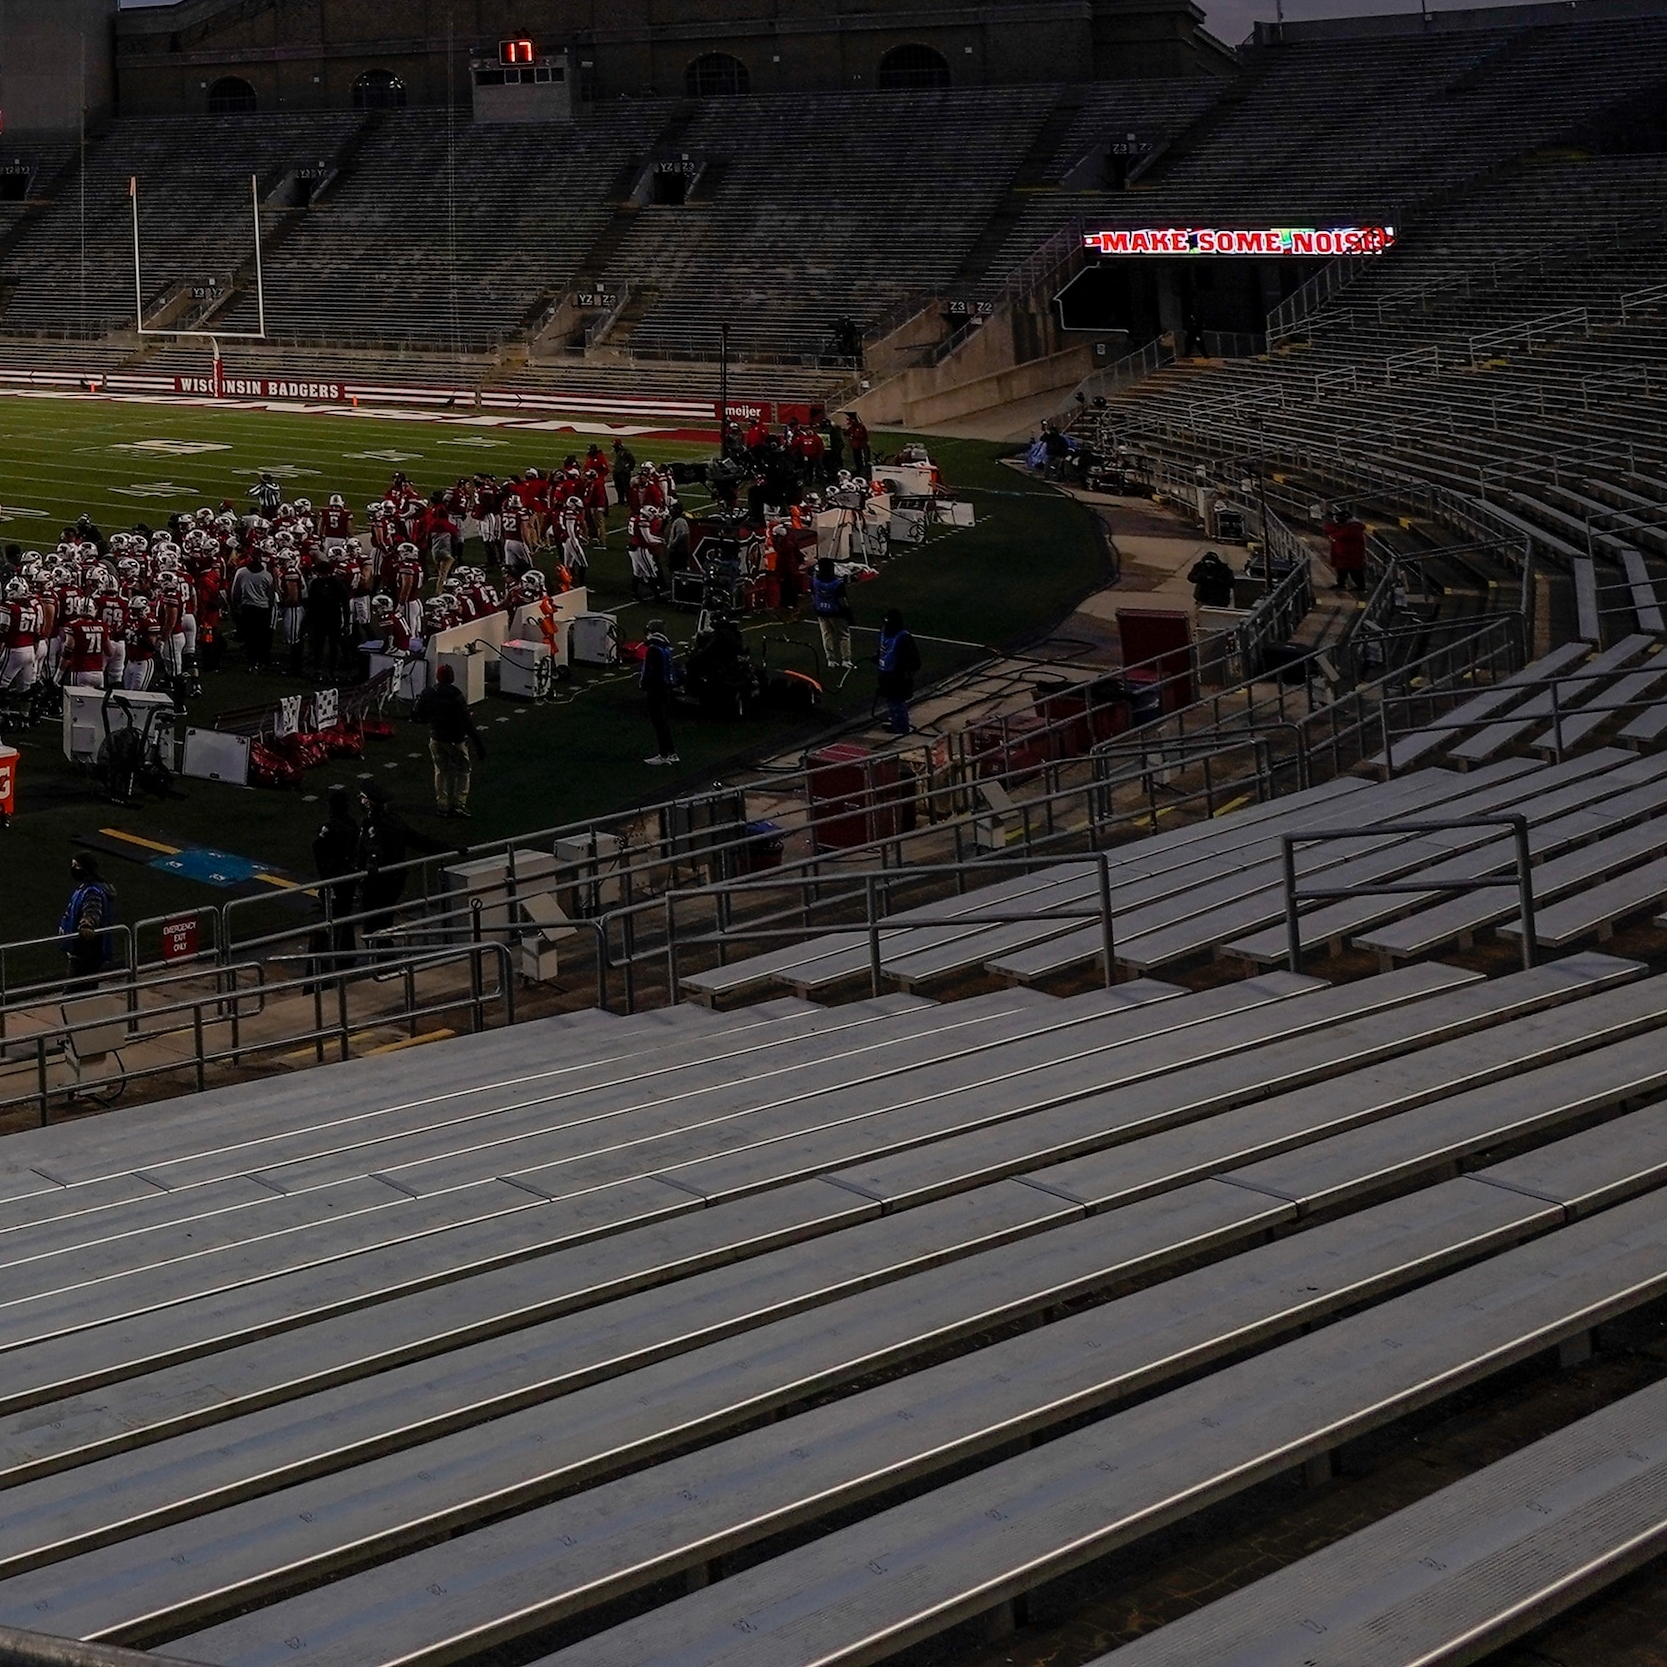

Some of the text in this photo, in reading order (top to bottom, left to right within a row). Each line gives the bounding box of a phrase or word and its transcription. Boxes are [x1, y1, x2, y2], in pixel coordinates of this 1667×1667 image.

[1102, 230, 1188, 254] MAKE
[1197, 232, 1282, 254] SOME
[949, 301, 966, 313] Z3
[268, 381, 340, 399] BADGERS
[724, 404, 762, 420] meijer
[85, 633, 102, 654] 71
[162, 921, 197, 936] EMERGENCY
[173, 933, 187, 943] EXIT
[173, 941, 187, 952] ONLY
